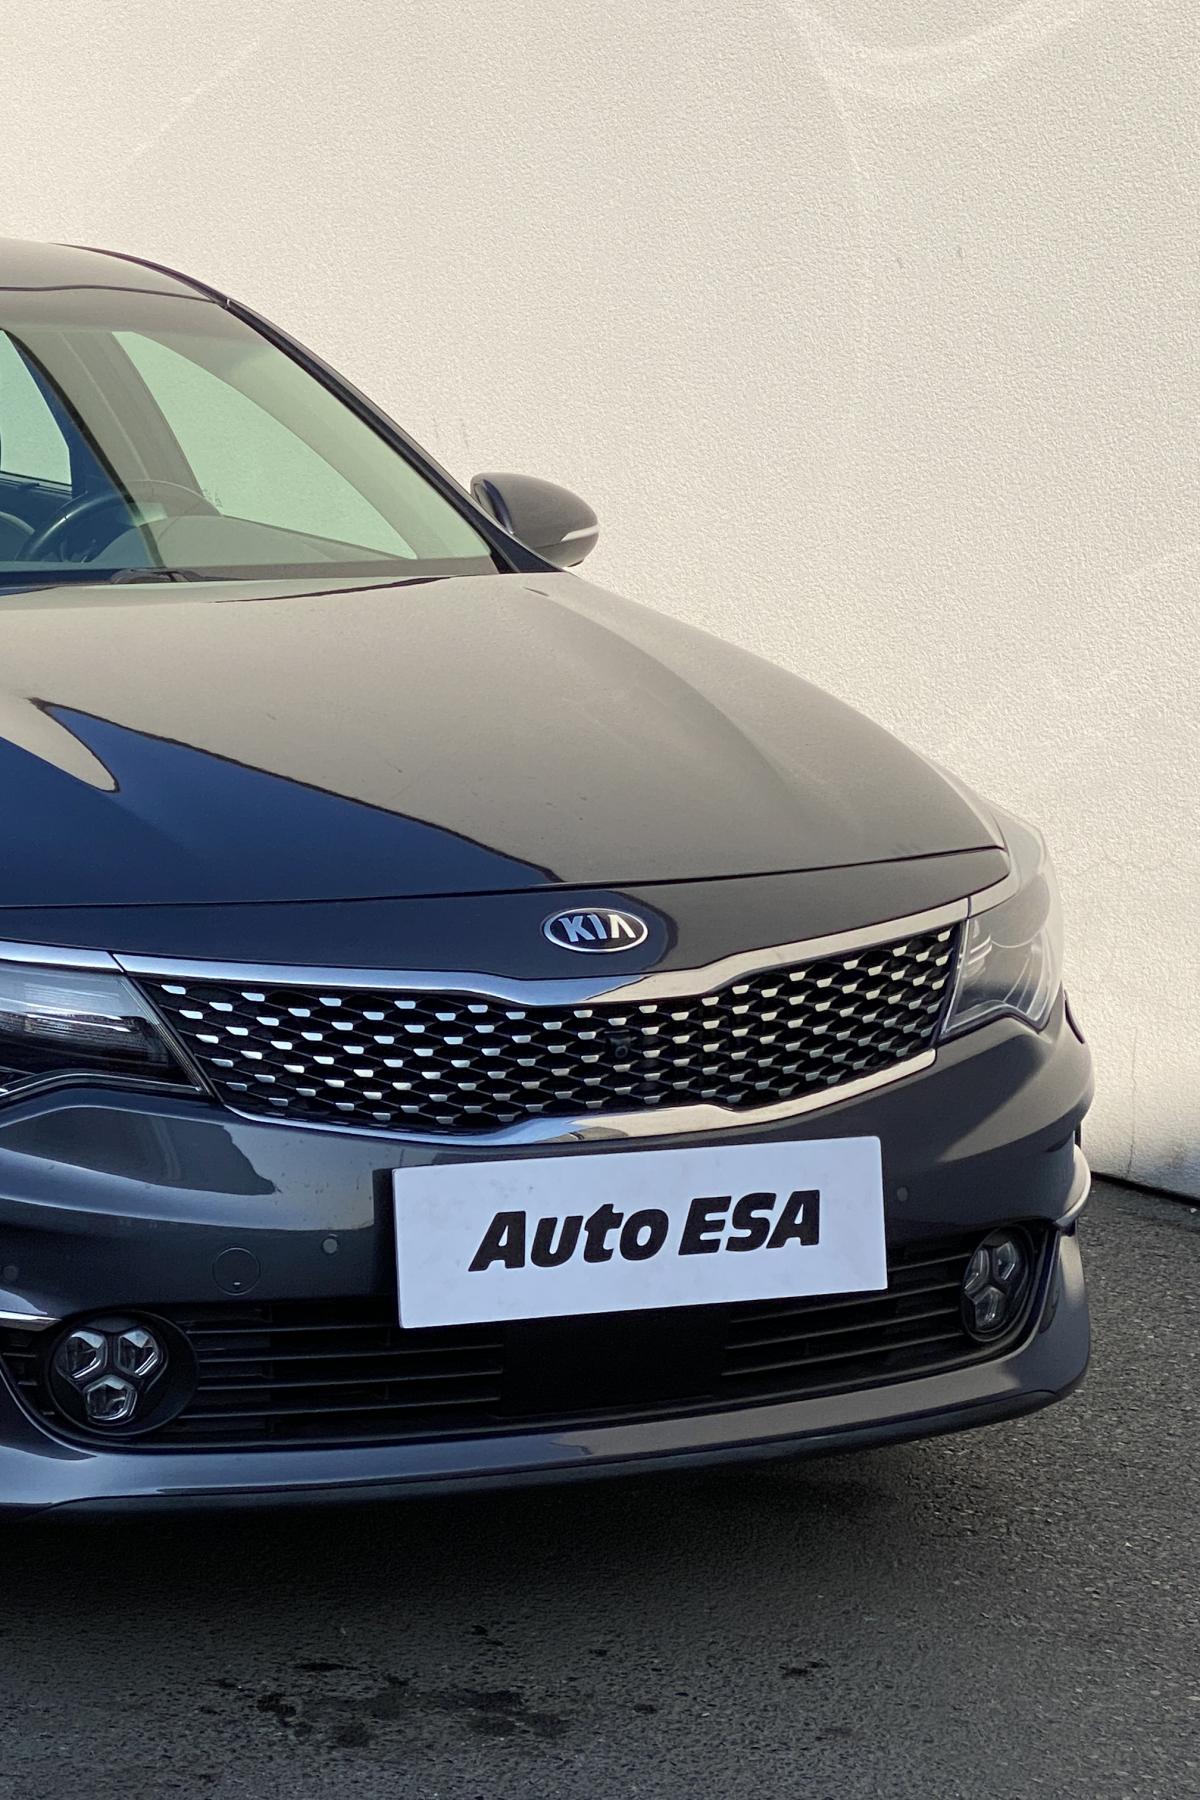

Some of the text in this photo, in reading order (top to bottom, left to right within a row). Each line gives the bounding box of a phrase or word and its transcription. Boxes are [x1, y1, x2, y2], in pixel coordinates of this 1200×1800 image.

[558, 914, 636, 942] KIA
[468, 1189, 820, 1272] Auto ESA
